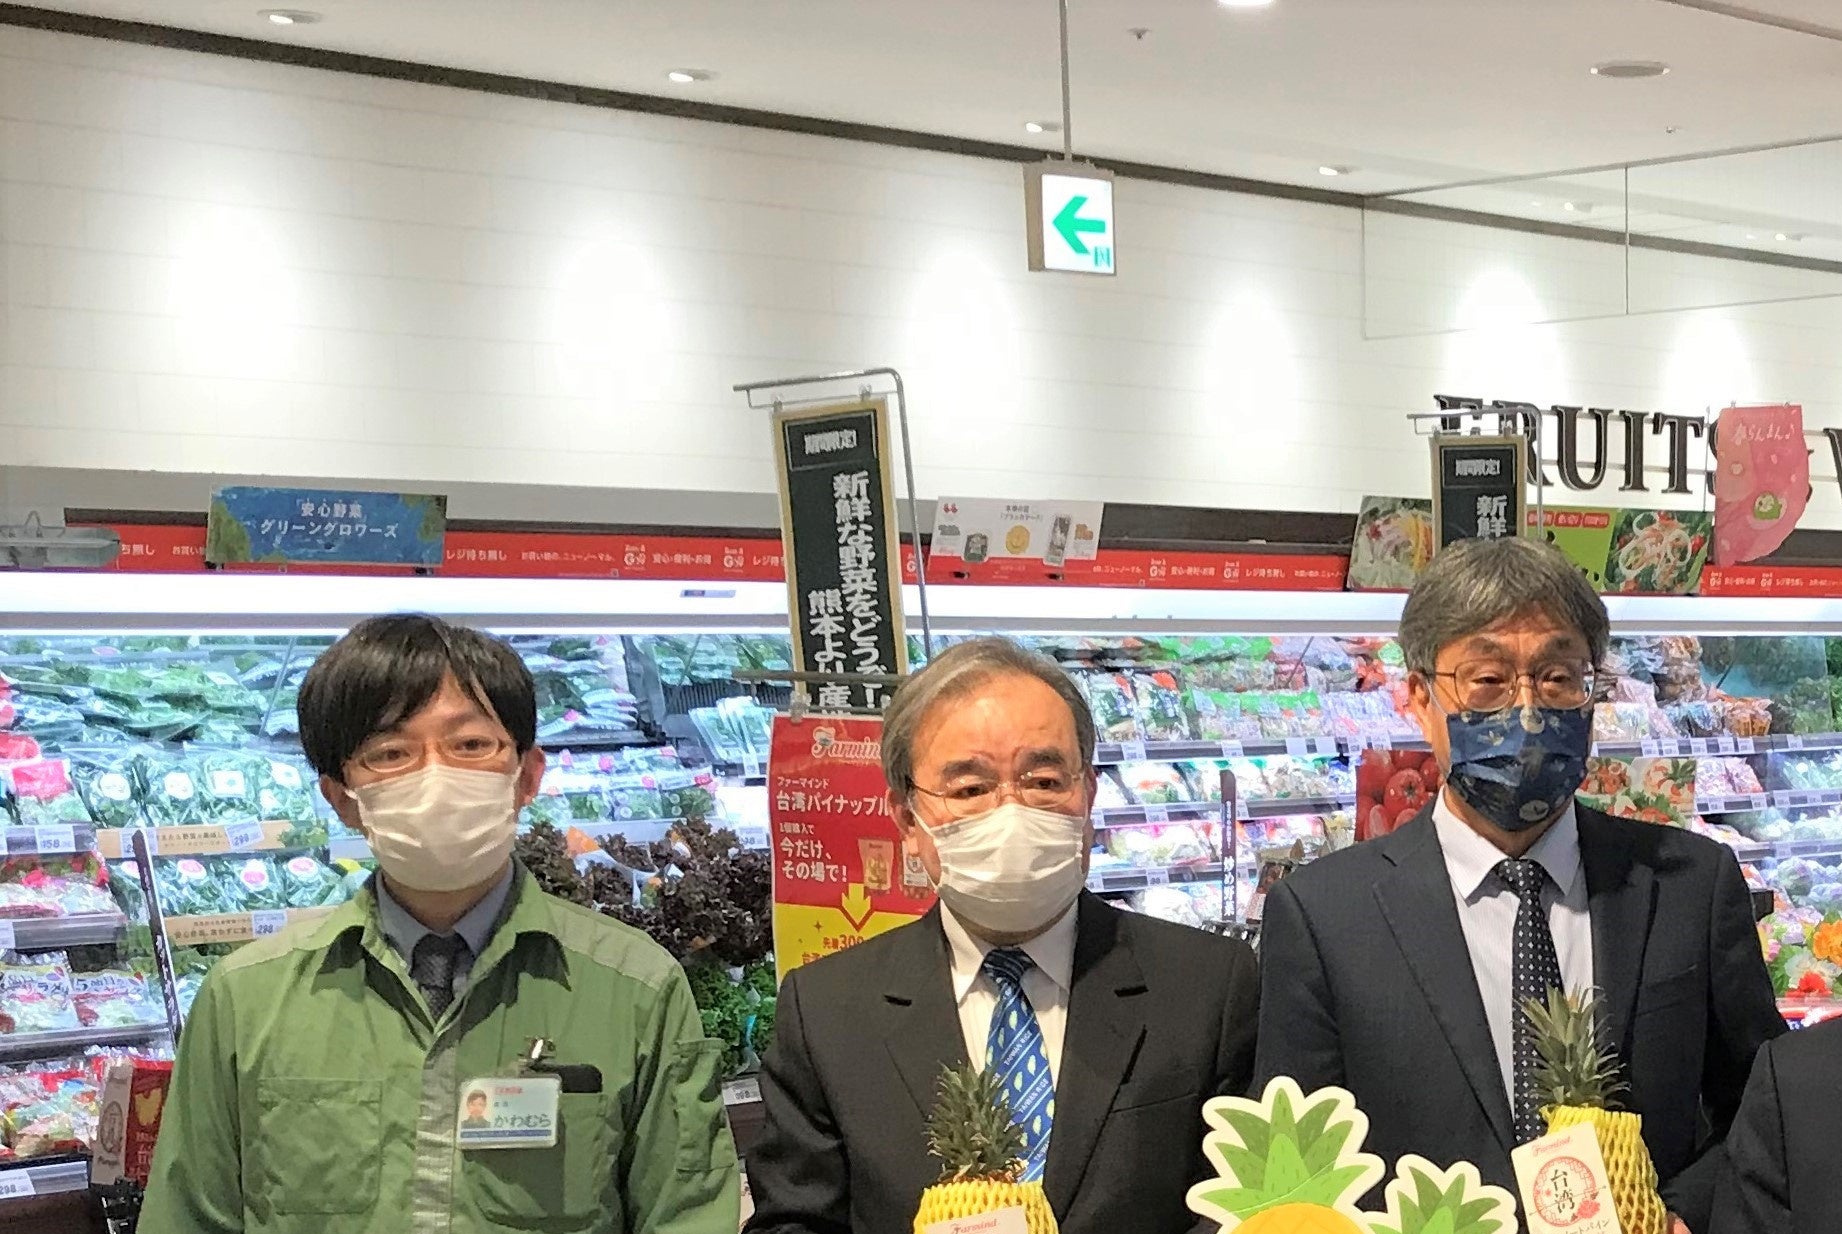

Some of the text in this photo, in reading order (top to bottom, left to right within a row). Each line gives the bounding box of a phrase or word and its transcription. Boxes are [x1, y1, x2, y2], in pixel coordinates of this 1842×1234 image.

[259, 518, 399, 539] グリーングロワーズ
[776, 790, 893, 817] 台湾パイナップル
[780, 839, 832, 861] 今だけ、
[782, 860, 848, 884] その場で!
